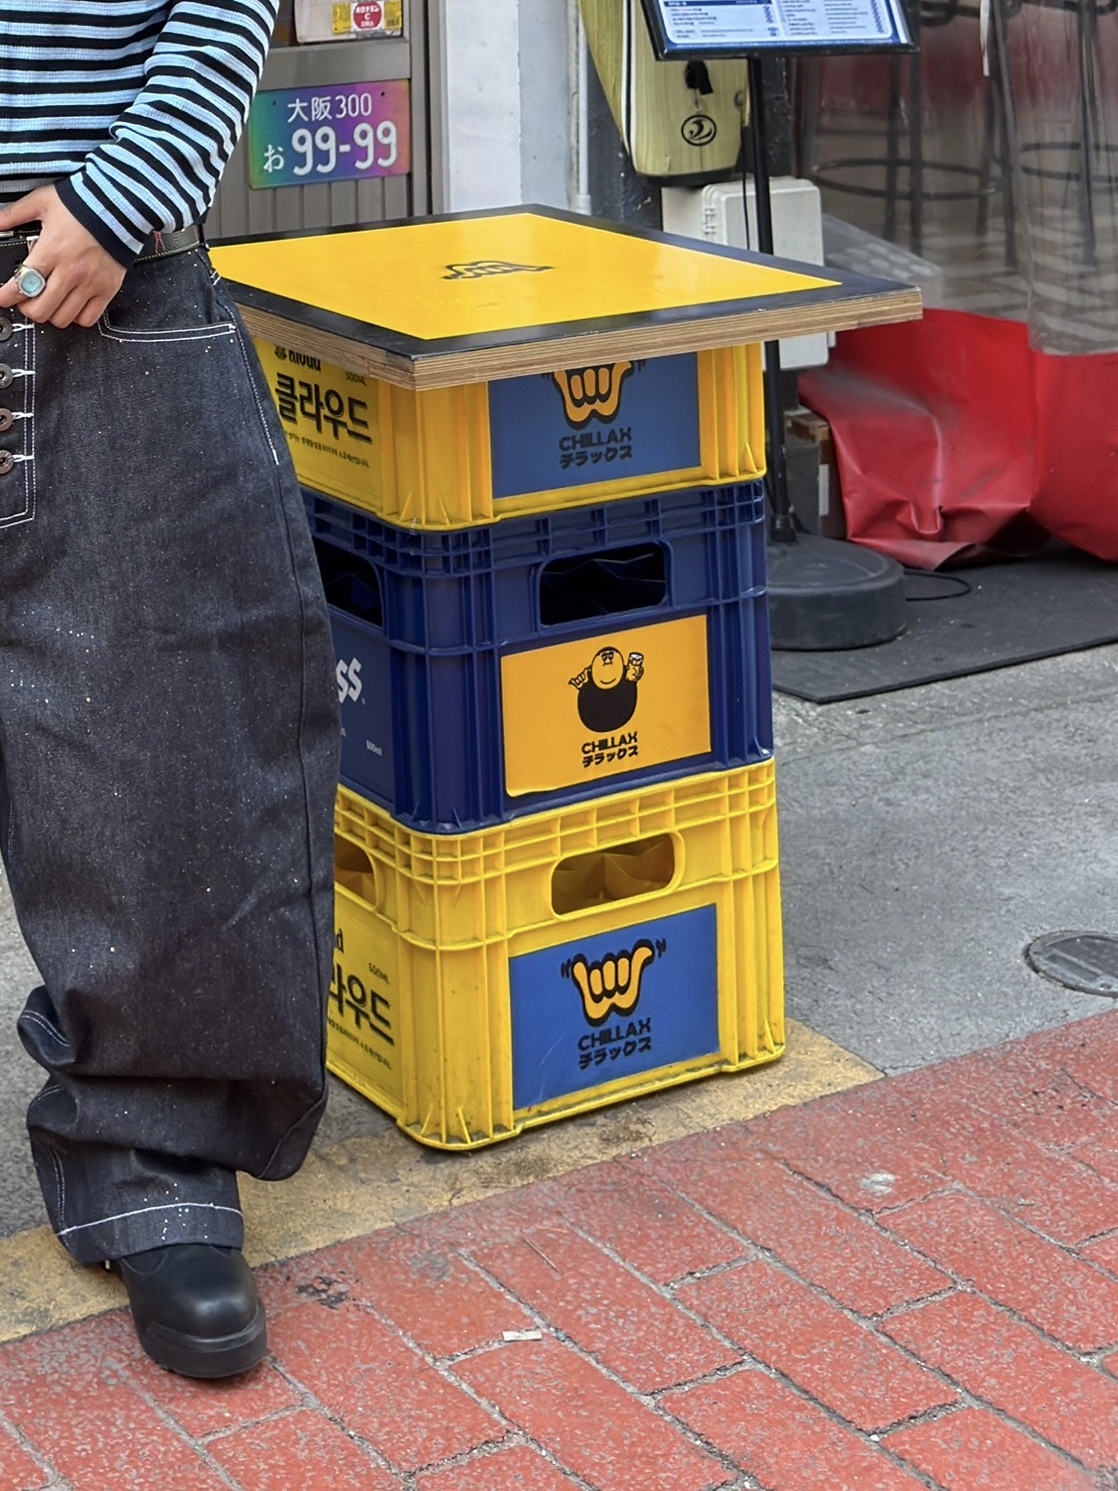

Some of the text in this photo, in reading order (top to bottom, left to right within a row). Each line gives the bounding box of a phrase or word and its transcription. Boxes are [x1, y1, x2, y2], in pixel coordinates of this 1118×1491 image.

[262, 120, 398, 177] お 99-99
[275, 371, 373, 446] 클라우드
[558, 426, 632, 452] CHILLAX
[581, 730, 638, 755] CHILLAX
[577, 1017, 652, 1052] CHILLAX
